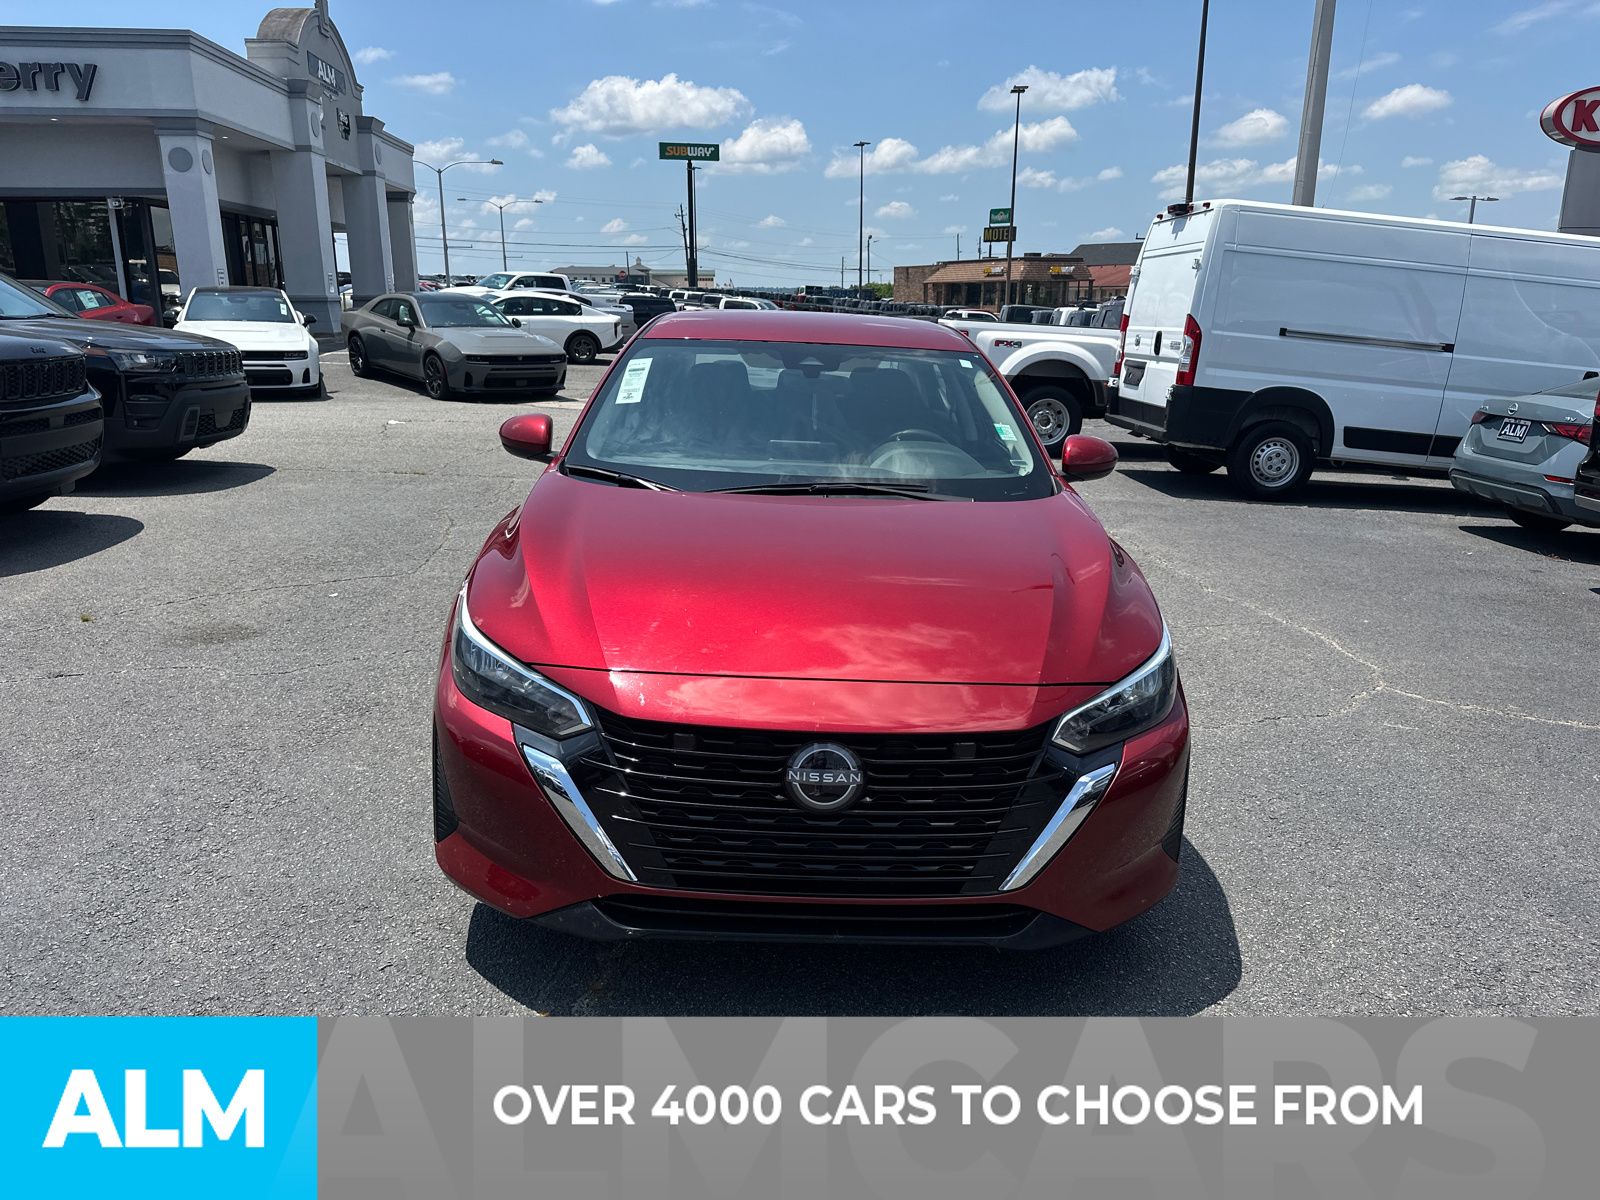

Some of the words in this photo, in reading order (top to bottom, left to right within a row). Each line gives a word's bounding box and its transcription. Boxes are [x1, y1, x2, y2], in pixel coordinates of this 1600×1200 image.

[318, 60, 336, 88] ALM
[665, 145, 715, 157] SUBWAY
[984, 228, 1014, 241] MOTE
[1501, 423, 1527, 437] ALM
[788, 770, 861, 783] NISSAN
